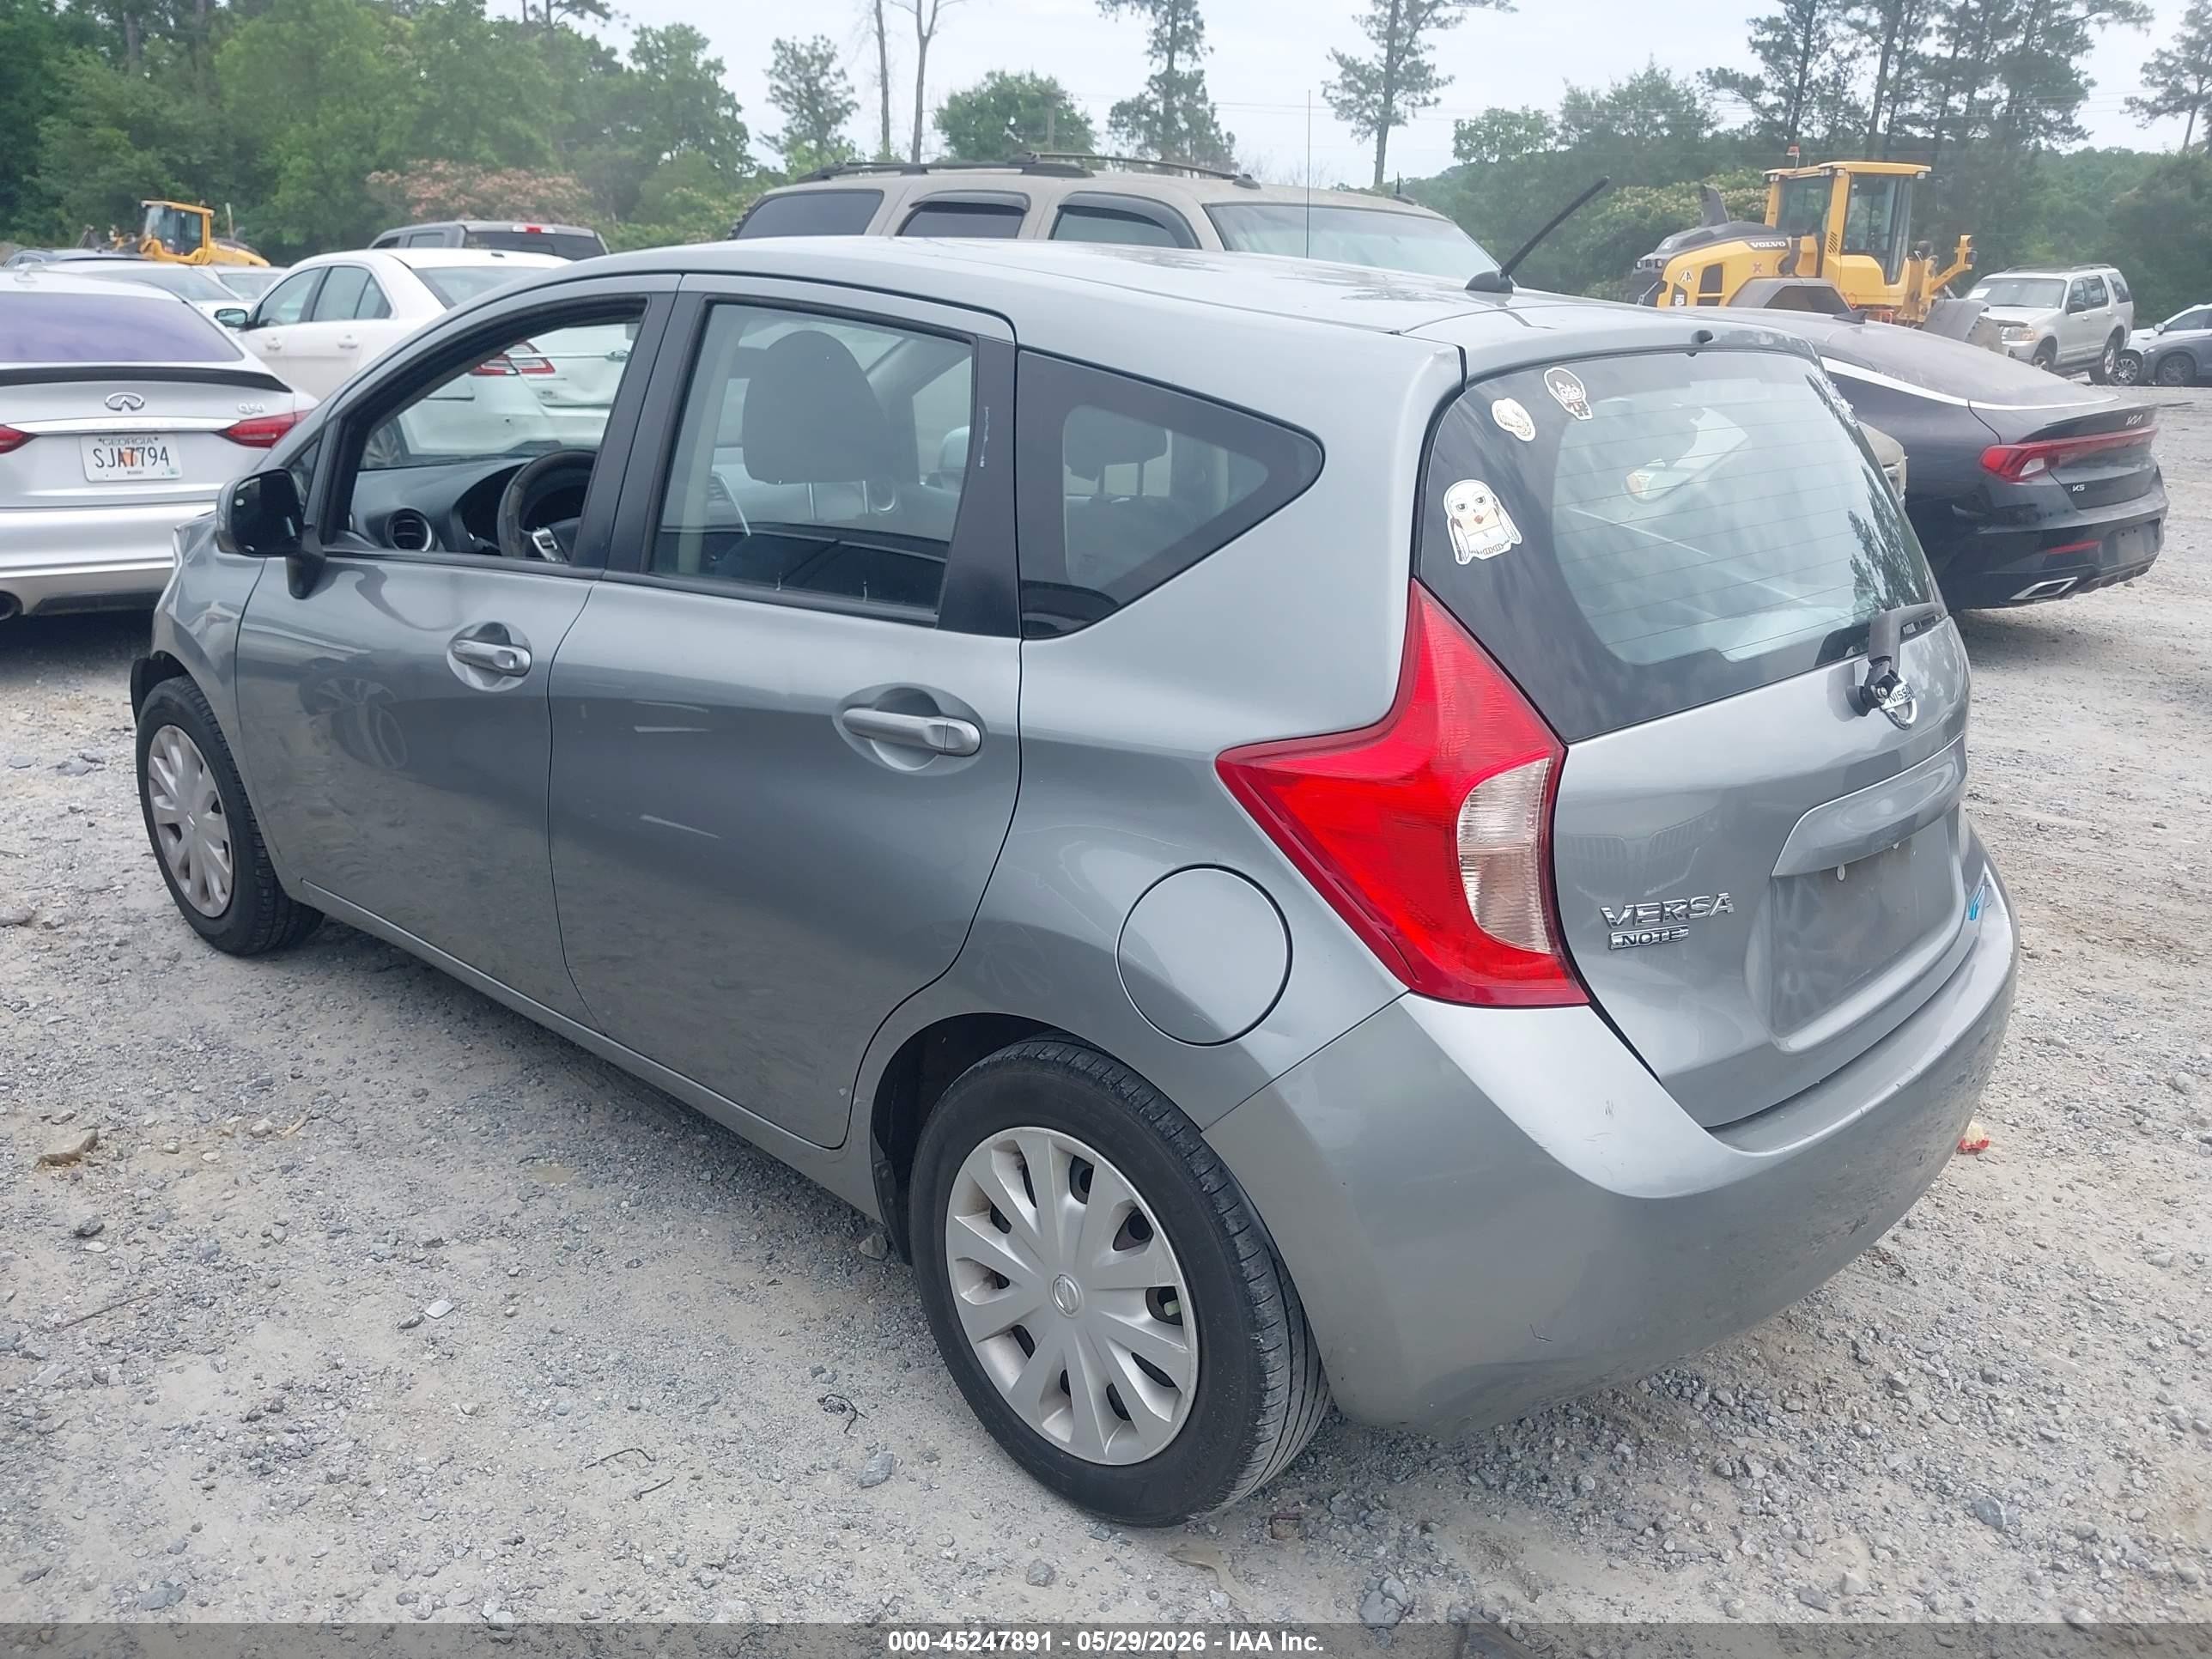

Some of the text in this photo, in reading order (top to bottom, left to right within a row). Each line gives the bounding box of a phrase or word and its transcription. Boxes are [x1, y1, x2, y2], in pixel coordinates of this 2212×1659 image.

[102, 438, 153, 447] GEORGIA
[93, 446, 169, 468] SJA7794
[2072, 483, 2085, 492] K5
[1600, 892, 1735, 928] VERSA
[1621, 928, 1683, 945] NOTE
